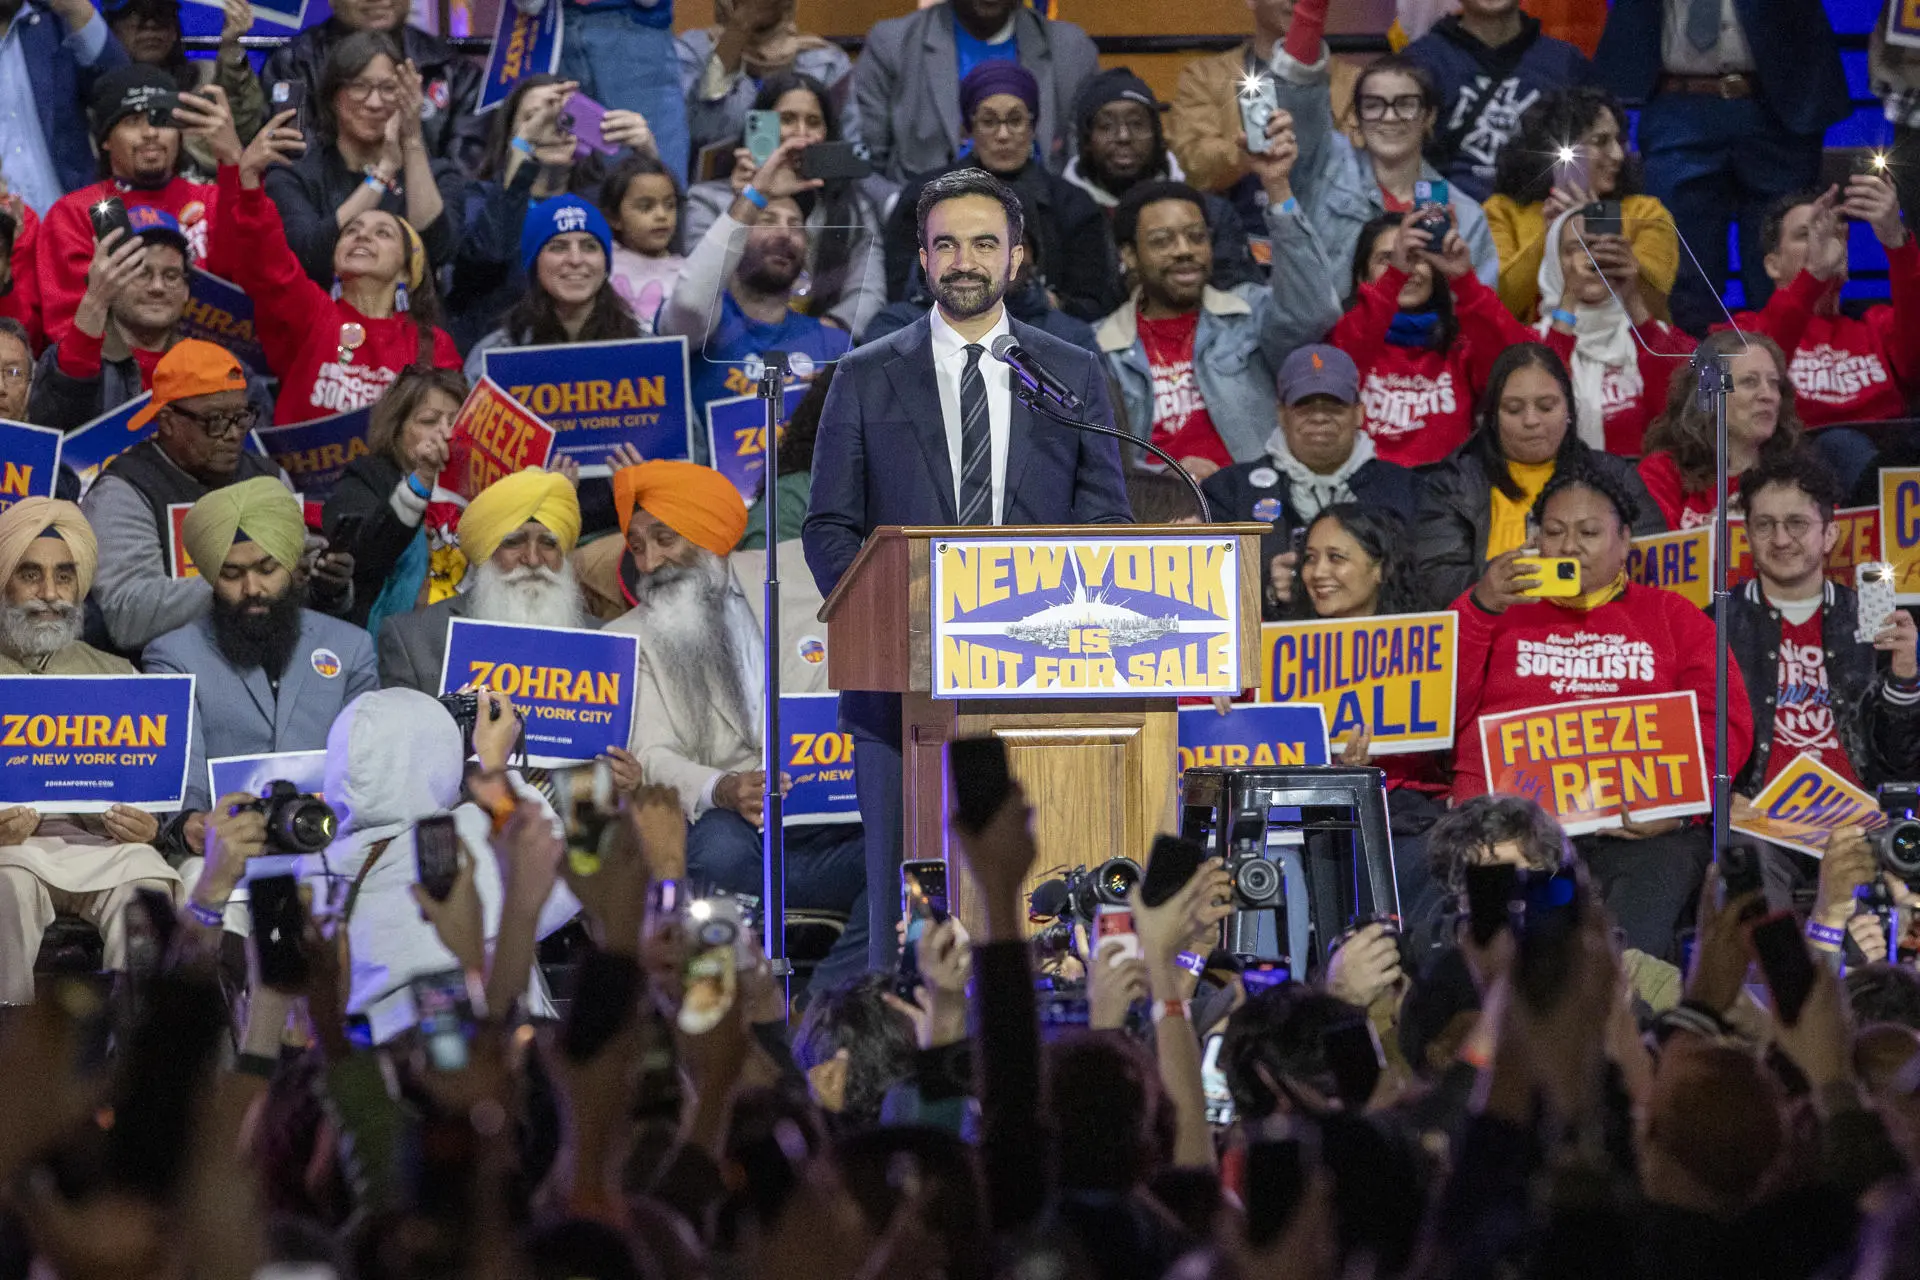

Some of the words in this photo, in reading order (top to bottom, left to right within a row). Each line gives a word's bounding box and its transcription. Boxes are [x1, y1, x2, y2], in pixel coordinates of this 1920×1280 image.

[580, 416, 620, 430] YORK
[624, 412, 661, 427] CITY
[1626, 540, 1699, 586] CARE
[943, 546, 1068, 623] NEW
[1071, 545, 1229, 620] YORK
[1069, 629, 1110, 653] IS
[1517, 639, 1655, 658] DEMOCRATIC
[943, 634, 1023, 690] NOT
[1035, 656, 1116, 688] FOR
[1128, 632, 1231, 687] SALE
[1272, 624, 1444, 702] CHILDCARE
[1516, 652, 1655, 682] SOCIALISTS
[470, 660, 621, 705] ZOHRAN
[536, 705, 577, 722] YORK
[579, 710, 613, 725] CITY
[1330, 680, 1438, 738] ALL
[1, 714, 169, 748] ZOHRAN
[1501, 704, 1664, 766] FREEZE
[32, 753, 70, 766] NEW
[74, 753, 117, 766] YORK
[120, 753, 157, 766] CITY
[789, 732, 855, 766] ZOH
[1178, 742, 1306, 768] OHRAN
[818, 769, 854, 782] NEW
[1552, 754, 1689, 816] RENT
